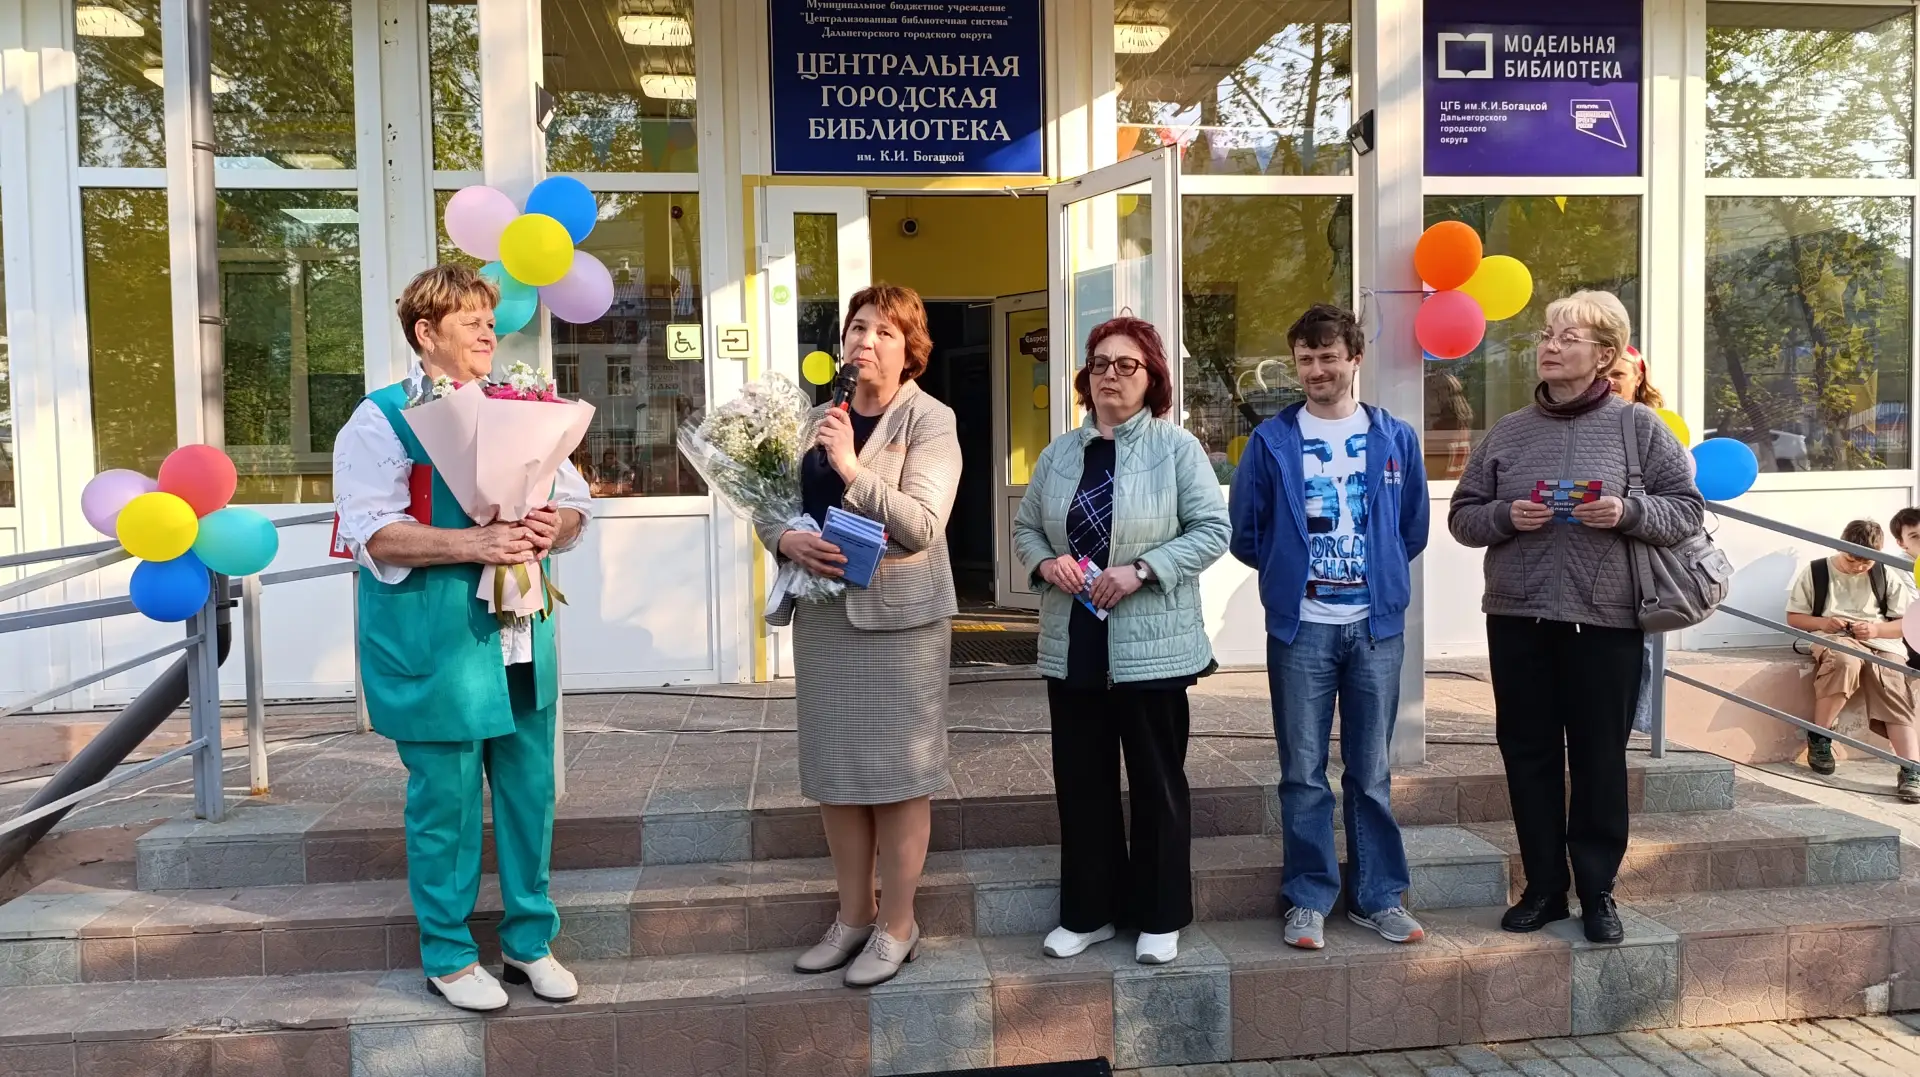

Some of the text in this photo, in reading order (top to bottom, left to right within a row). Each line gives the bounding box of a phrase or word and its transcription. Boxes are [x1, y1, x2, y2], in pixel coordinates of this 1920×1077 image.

[807, 0, 1005, 13] Муниципальное бюджетное учреждение
[799, 12, 1012, 25] "Централизованная библиотечная система"
[822, 27, 992, 41] Дальнегорского городского округа
[1505, 35, 1614, 57] МОДЕЛЬНАЯ
[797, 53, 1019, 79] ЦЕНТРАЛЬНАЯ
[1505, 60, 1622, 78] БИБЛИОТЕКА
[821, 86, 996, 112] ГОРОДСКАЯ
[1440, 101, 1547, 111] ЦГБ им.К.И.Богацкой
[1440, 114, 1507, 122] Дальнегорского
[809, 118, 1011, 140] БИБЛИОТЕКА
[1440, 126, 1487, 134] городского
[856, 150, 964, 164] им. К.И. Богацкой
